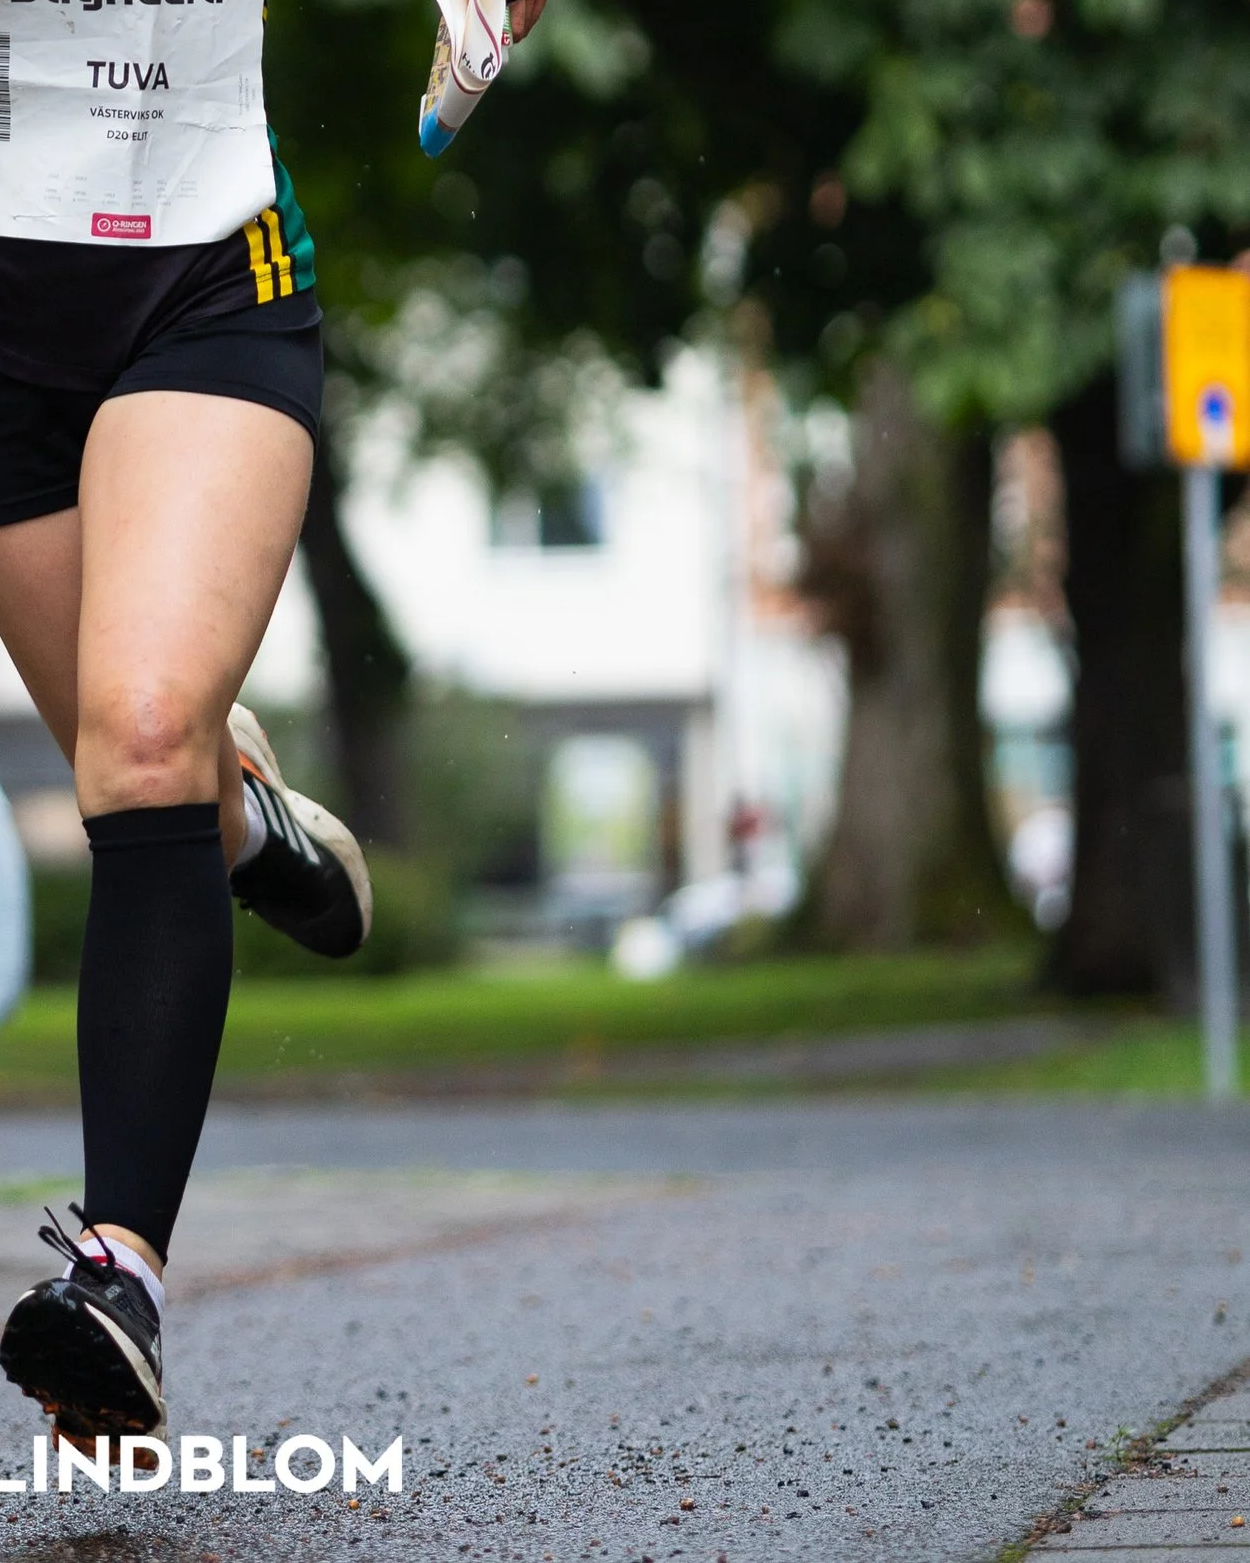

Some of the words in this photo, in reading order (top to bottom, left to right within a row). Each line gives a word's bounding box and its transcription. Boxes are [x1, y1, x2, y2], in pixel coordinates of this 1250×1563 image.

[86, 60, 170, 90] TUVA
[90, 106, 150, 120] VÄSTERVIKS
[151, 110, 164, 120] OK
[107, 129, 129, 140] D20
